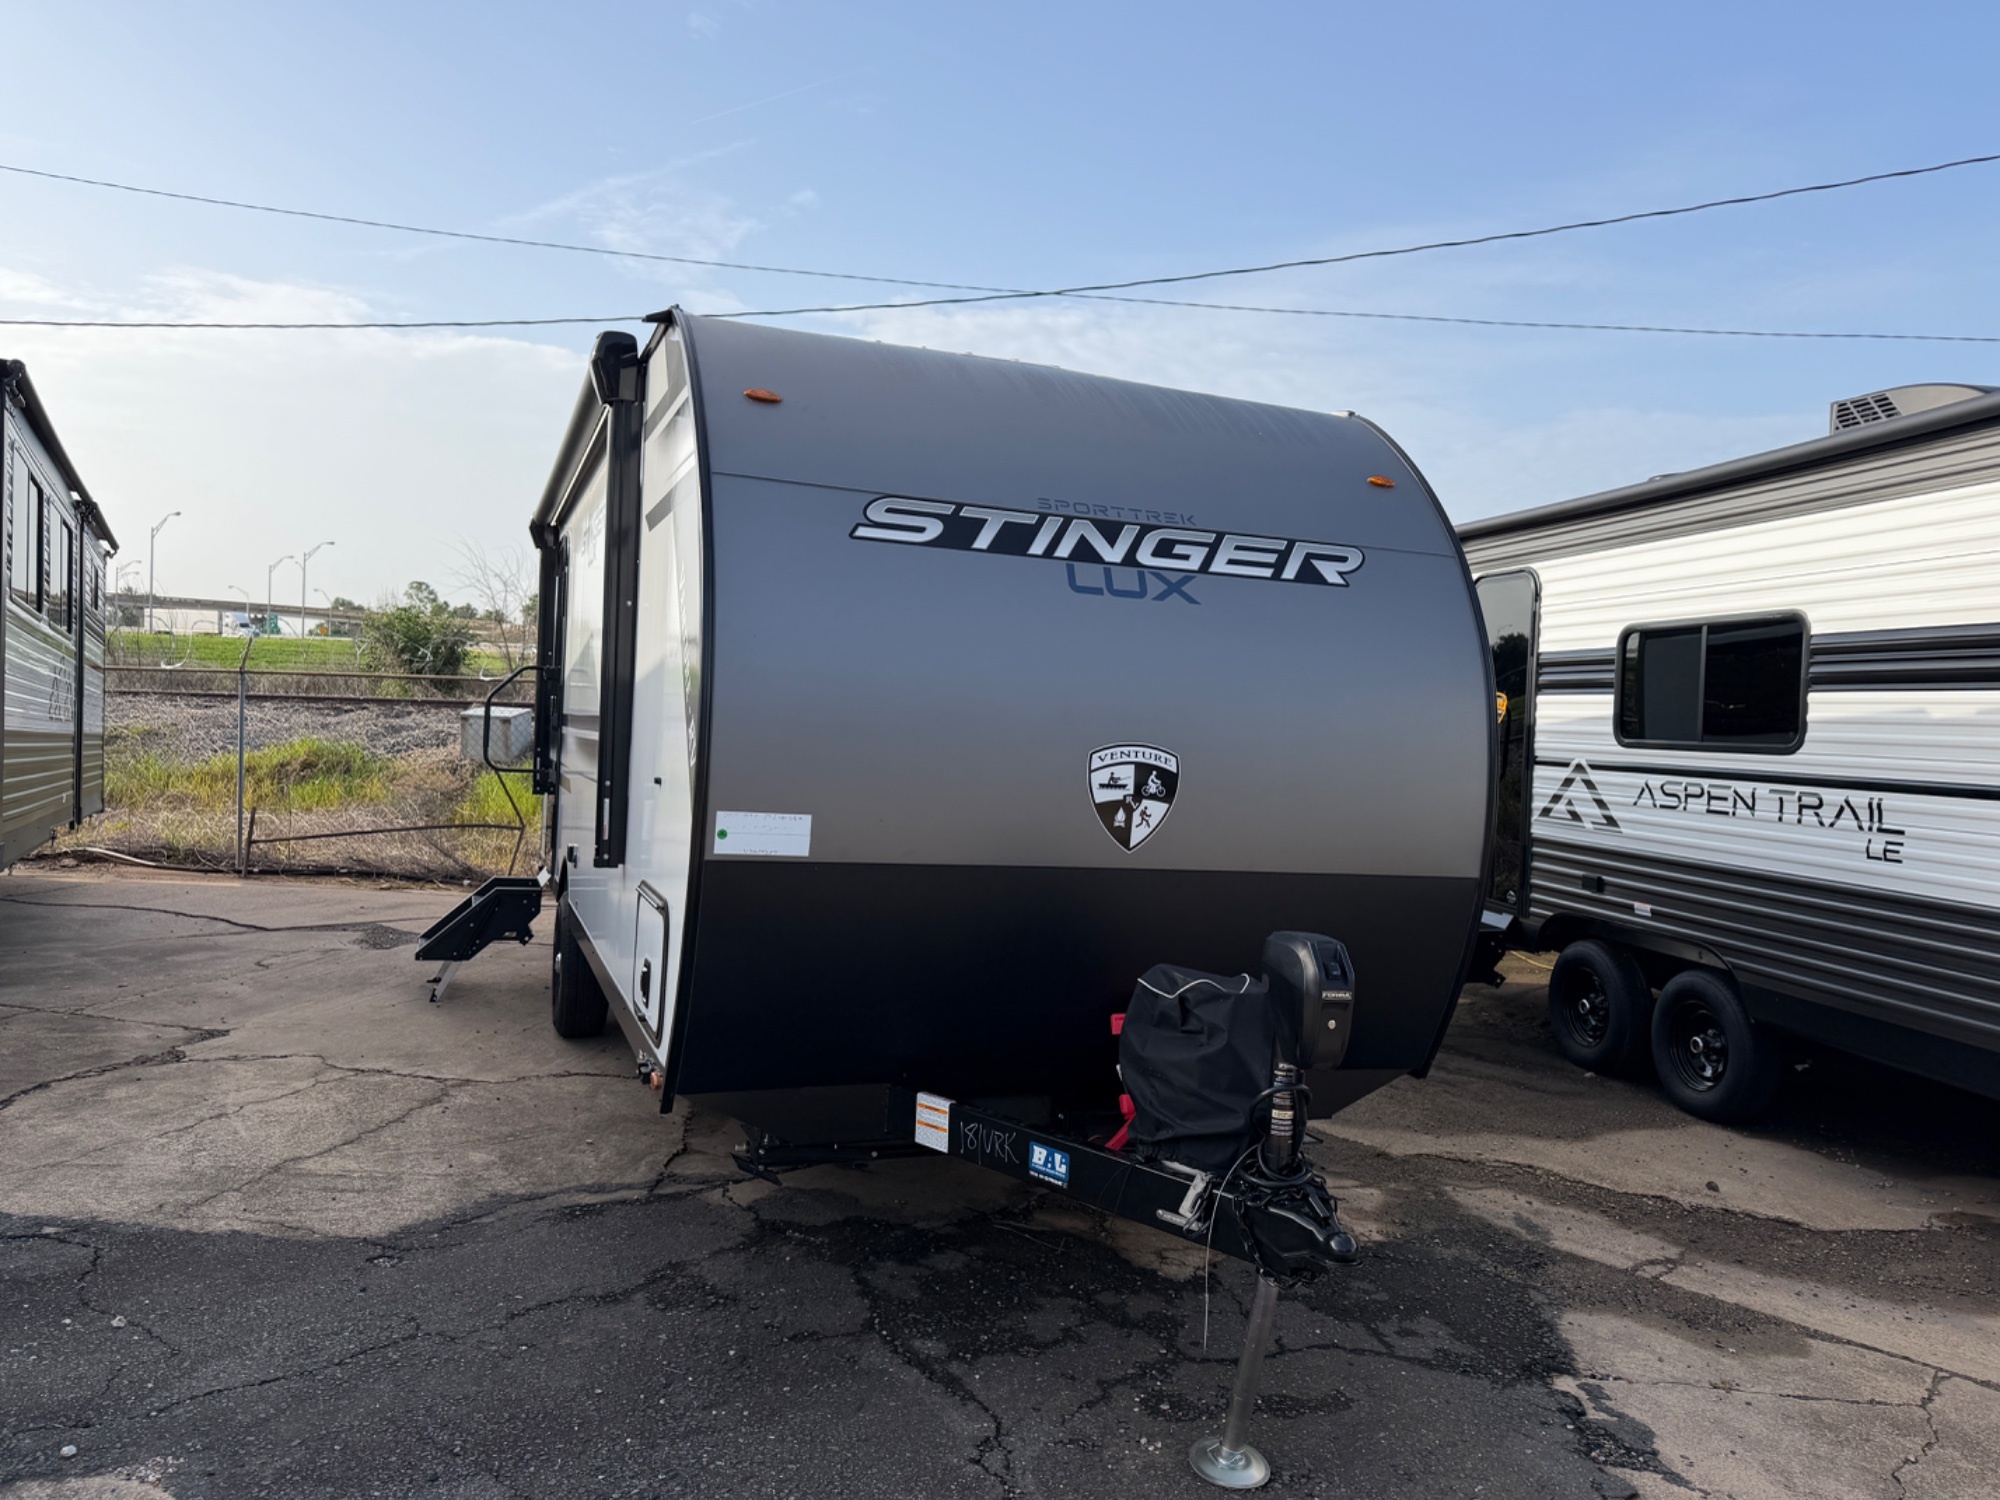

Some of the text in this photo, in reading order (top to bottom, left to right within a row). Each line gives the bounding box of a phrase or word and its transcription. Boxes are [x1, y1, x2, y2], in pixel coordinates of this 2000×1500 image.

[1037, 497, 1197, 526] SPORTTREK
[850, 495, 1364, 586] STINGER
[1066, 563, 1202, 605] LUX
[1098, 750, 1172, 767] VENTURE
[1633, 780, 1906, 836] ASPEN TRAIL
[1865, 838, 1905, 864] LE
